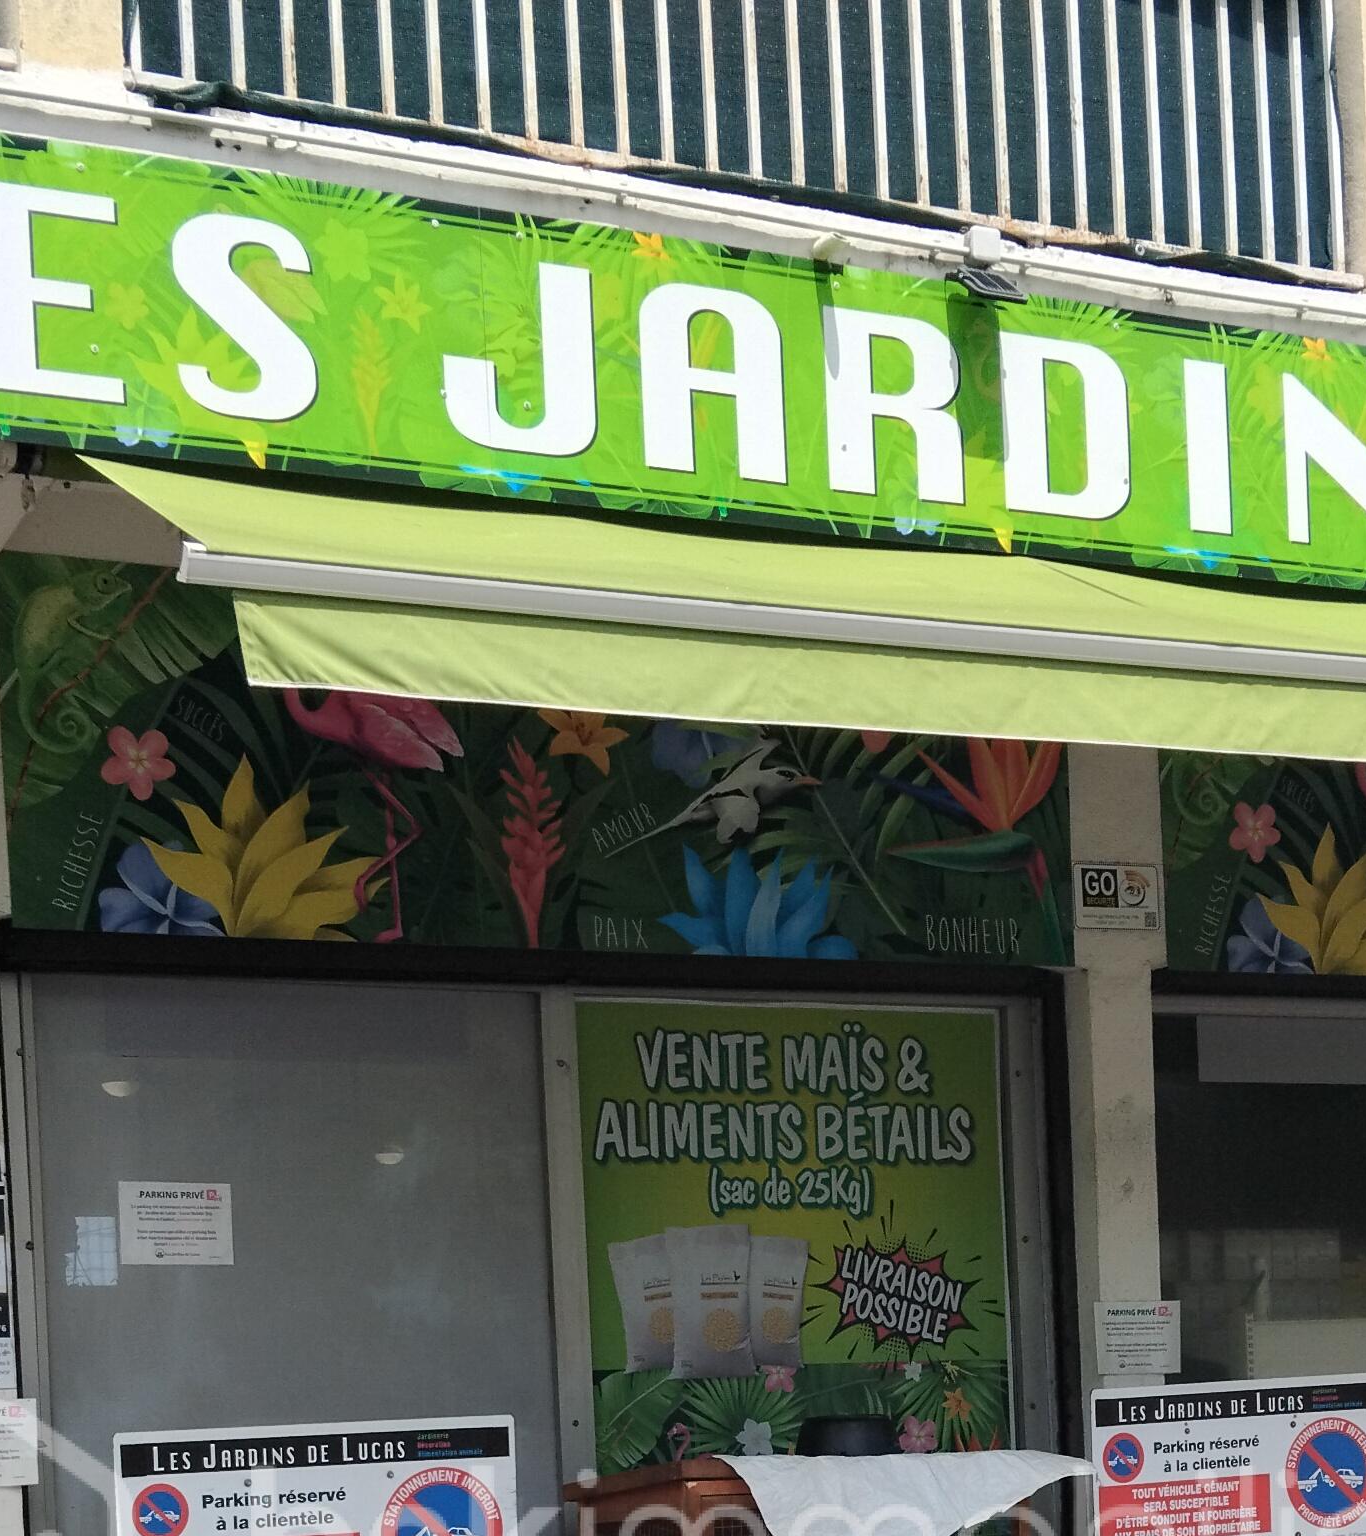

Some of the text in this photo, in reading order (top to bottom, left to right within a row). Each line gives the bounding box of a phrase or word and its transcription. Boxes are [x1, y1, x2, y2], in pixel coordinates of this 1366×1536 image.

[591, 802, 656, 853] AMOUR
[51, 811, 104, 912] RICHESSE
[1085, 871, 1115, 896] GO
[1194, 873, 1232, 956] RICHESSE
[594, 915, 648, 949] PAIX
[925, 914, 1019, 955] BONHEUR
[635, 1023, 931, 1094] VENTE MAÏS &
[593, 1091, 973, 1162] ALIMENTS BÉTAILS
[139, 1189, 205, 1199] PARKING PRIVÉ
[711, 1166, 872, 1215] (sac de 25Kg)
[841, 1246, 963, 1313] LIVRAISON
[840, 1288, 949, 1345] POSSIBLE
[1107, 1307, 1157, 1316] PARKING PRIVÉ
[1118, 1401, 1146, 1422] LES
[1154, 1398, 1222, 1420] JARDINS
[1230, 1398, 1247, 1415] DE
[1256, 1392, 1304, 1413] LUCAS
[152, 1436, 406, 1472] LES JARDINS DE LUCAS
[1153, 1434, 1260, 1454] Parking réservé
[1287, 1419, 1348, 1469] STATIONNEMENT
[1164, 1455, 1251, 1473] à la clientèle
[202, 1487, 346, 1509] Parking réservé
[384, 1469, 500, 1527] STATIONNEMENT INTERDIT
[1132, 1480, 1240, 1500] TOUT VÉHICULE GÊNANT
[1143, 1495, 1229, 1513] SERA SUSCEPTIBLE
[216, 1511, 334, 1531] à la clientèle
[1116, 1505, 1257, 1529] D'ÊTRE CONDUIT EN FOURRIÈRE
[1177, 1525, 1195, 1536] SON
[1197, 1519, 1260, 1535] PROPRIÉTAIRE
